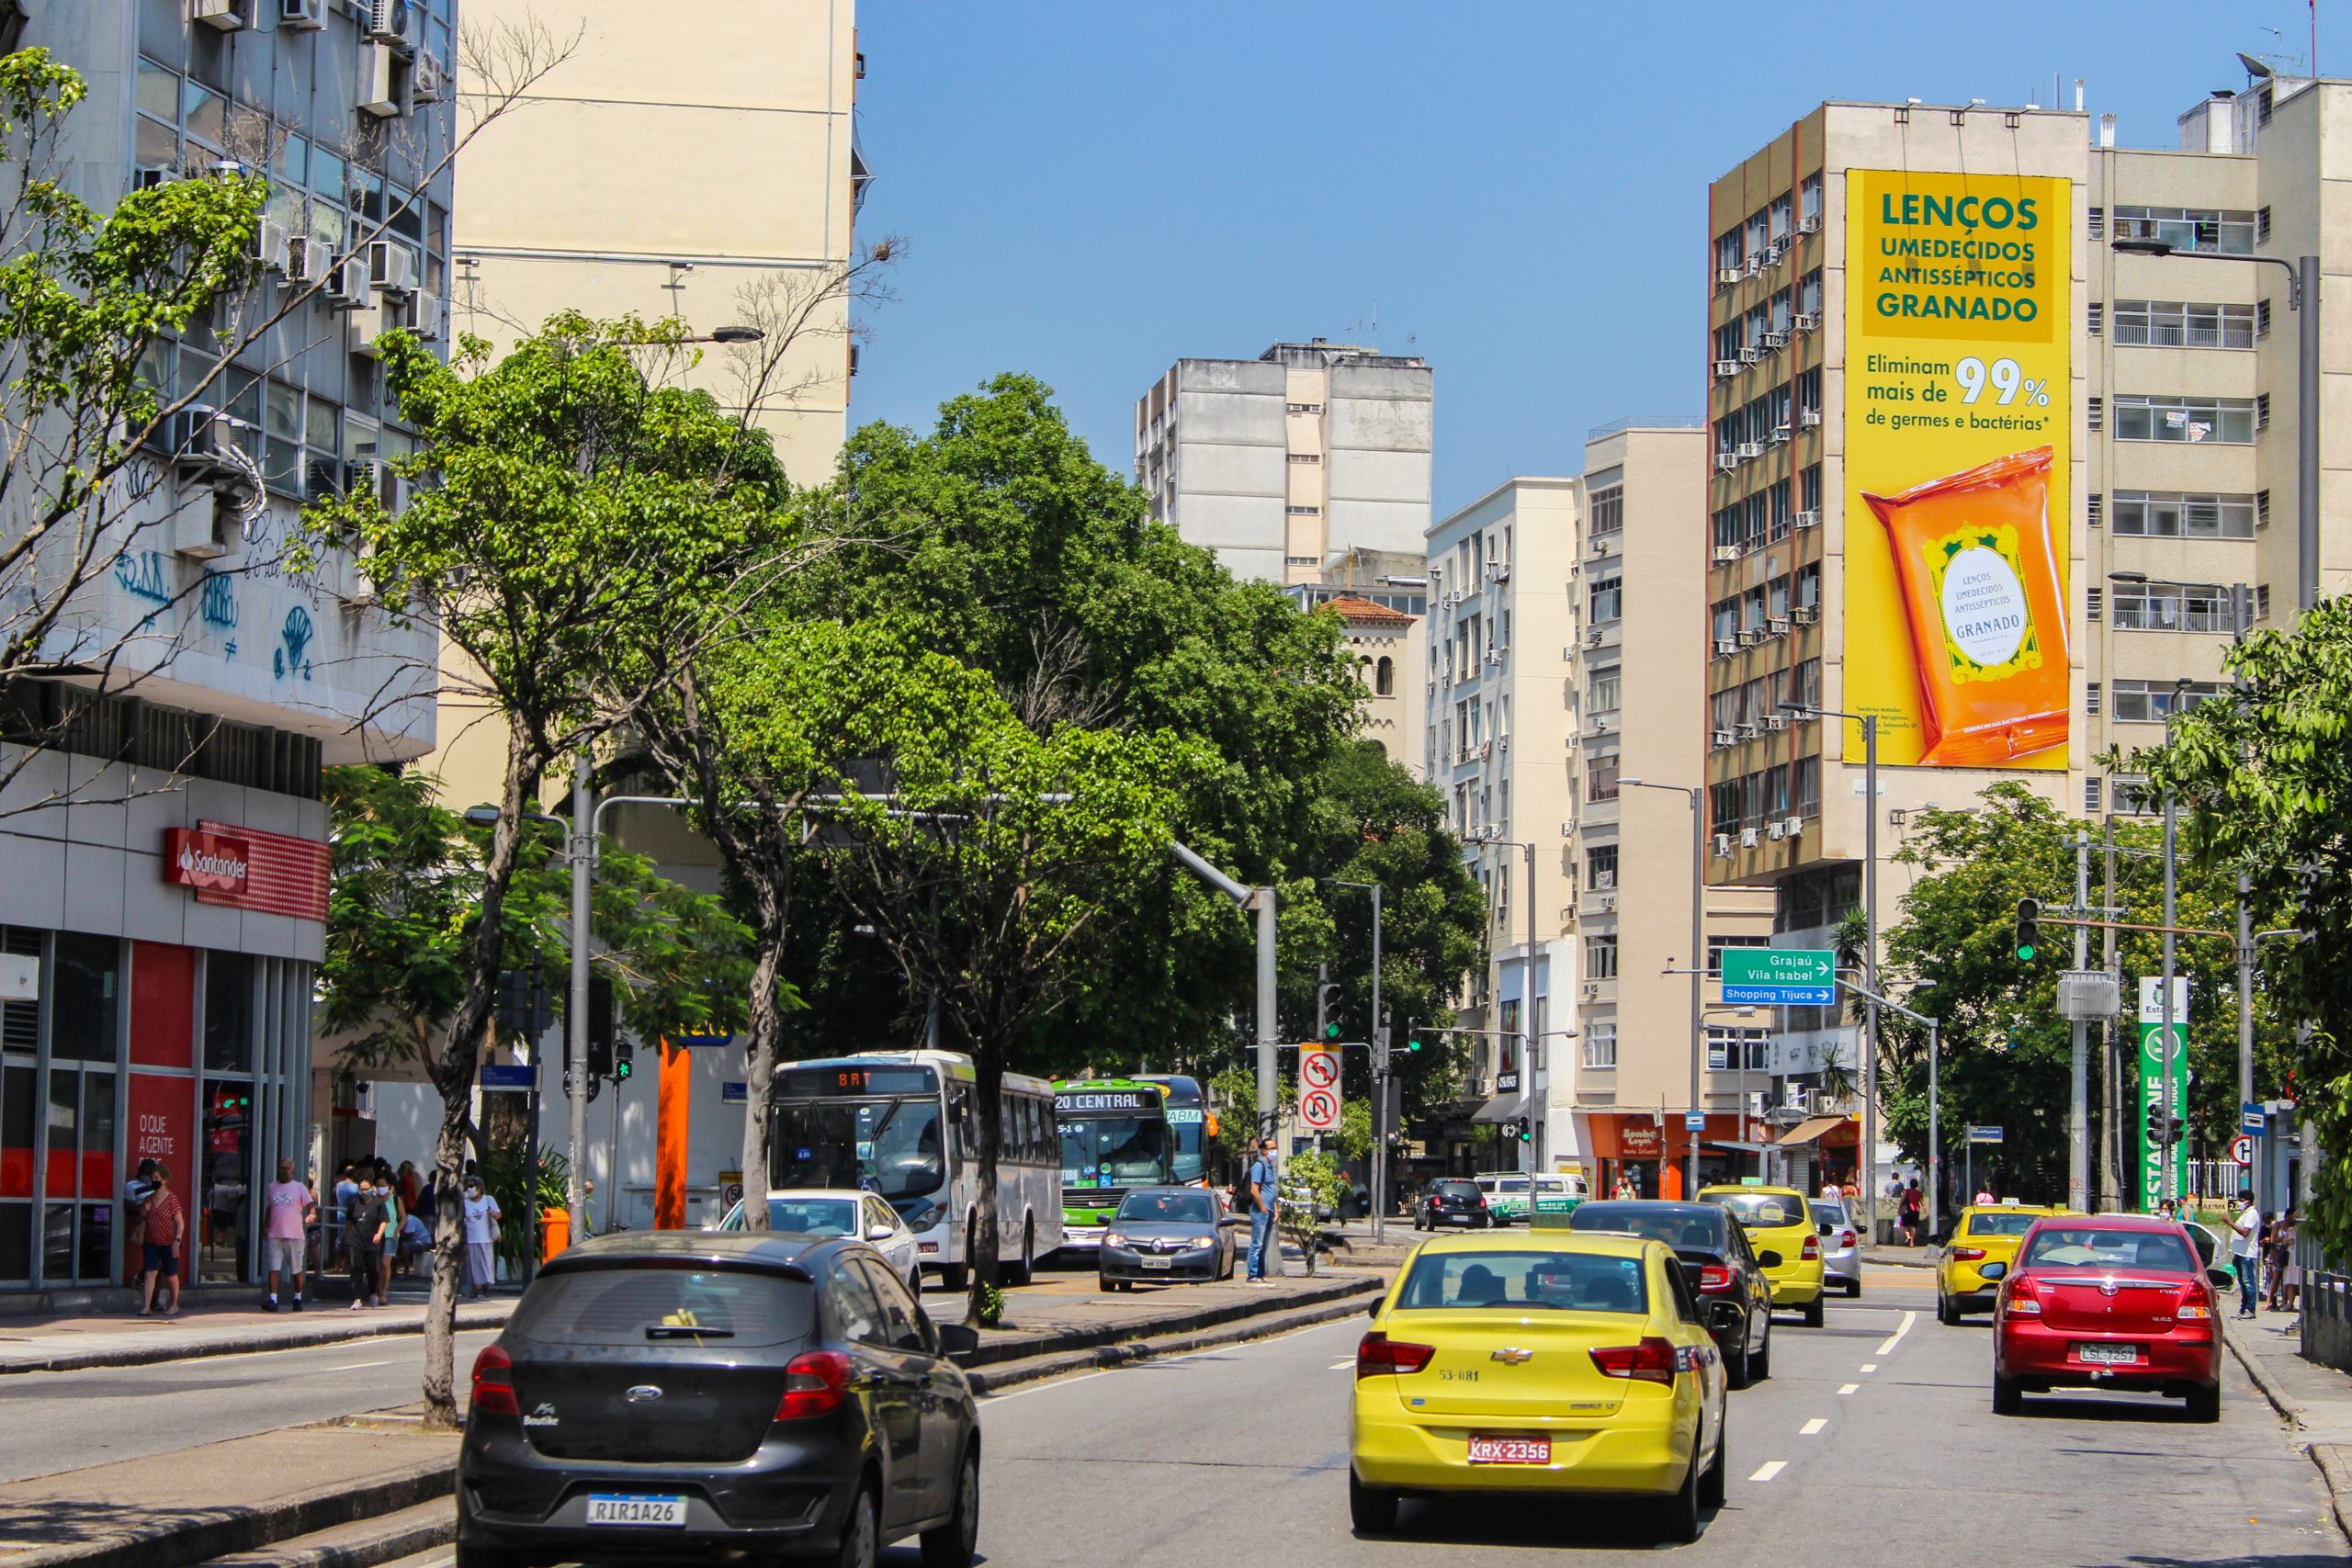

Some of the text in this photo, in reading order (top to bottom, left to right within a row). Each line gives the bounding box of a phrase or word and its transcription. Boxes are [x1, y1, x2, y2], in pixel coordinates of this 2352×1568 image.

[1883, 193, 2038, 236] LENÇOS
[1881, 237, 2035, 262] UMEDECIDOS
[1879, 265, 2036, 289] ANTISSÉPTICOS
[1876, 292, 2038, 322] GRANADO
[1867, 354, 1950, 376] Eliminam
[1867, 355, 2050, 408] mais de 99%
[1866, 407, 1886, 425] de
[1891, 414, 1950, 431] germes
[1955, 416, 1964, 428] e
[1962, 572, 1992, 586] LENÇOS
[1956, 582, 2004, 601] UMEDECIDOS
[1956, 614, 2020, 639] GRANADO
[194, 849, 247, 879] Santander
[1770, 955, 1812, 967] Grajaú
[1747, 970, 1813, 980] Vila Isabel
[1726, 989, 1813, 1000] Shopping Tijuca
[839, 1072, 871, 1087] BRT
[1076, 1094, 1141, 1108] CENTRAL
[140, 1114, 167, 1134] O QUE
[1167, 1111, 1199, 1122] ABM
[139, 1136, 174, 1155] A GENTE
[2082, 1348, 2134, 1360] LSL-7257
[1439, 1369, 1480, 1382] 53-081
[595, 1502, 674, 1521] RIR1A26
